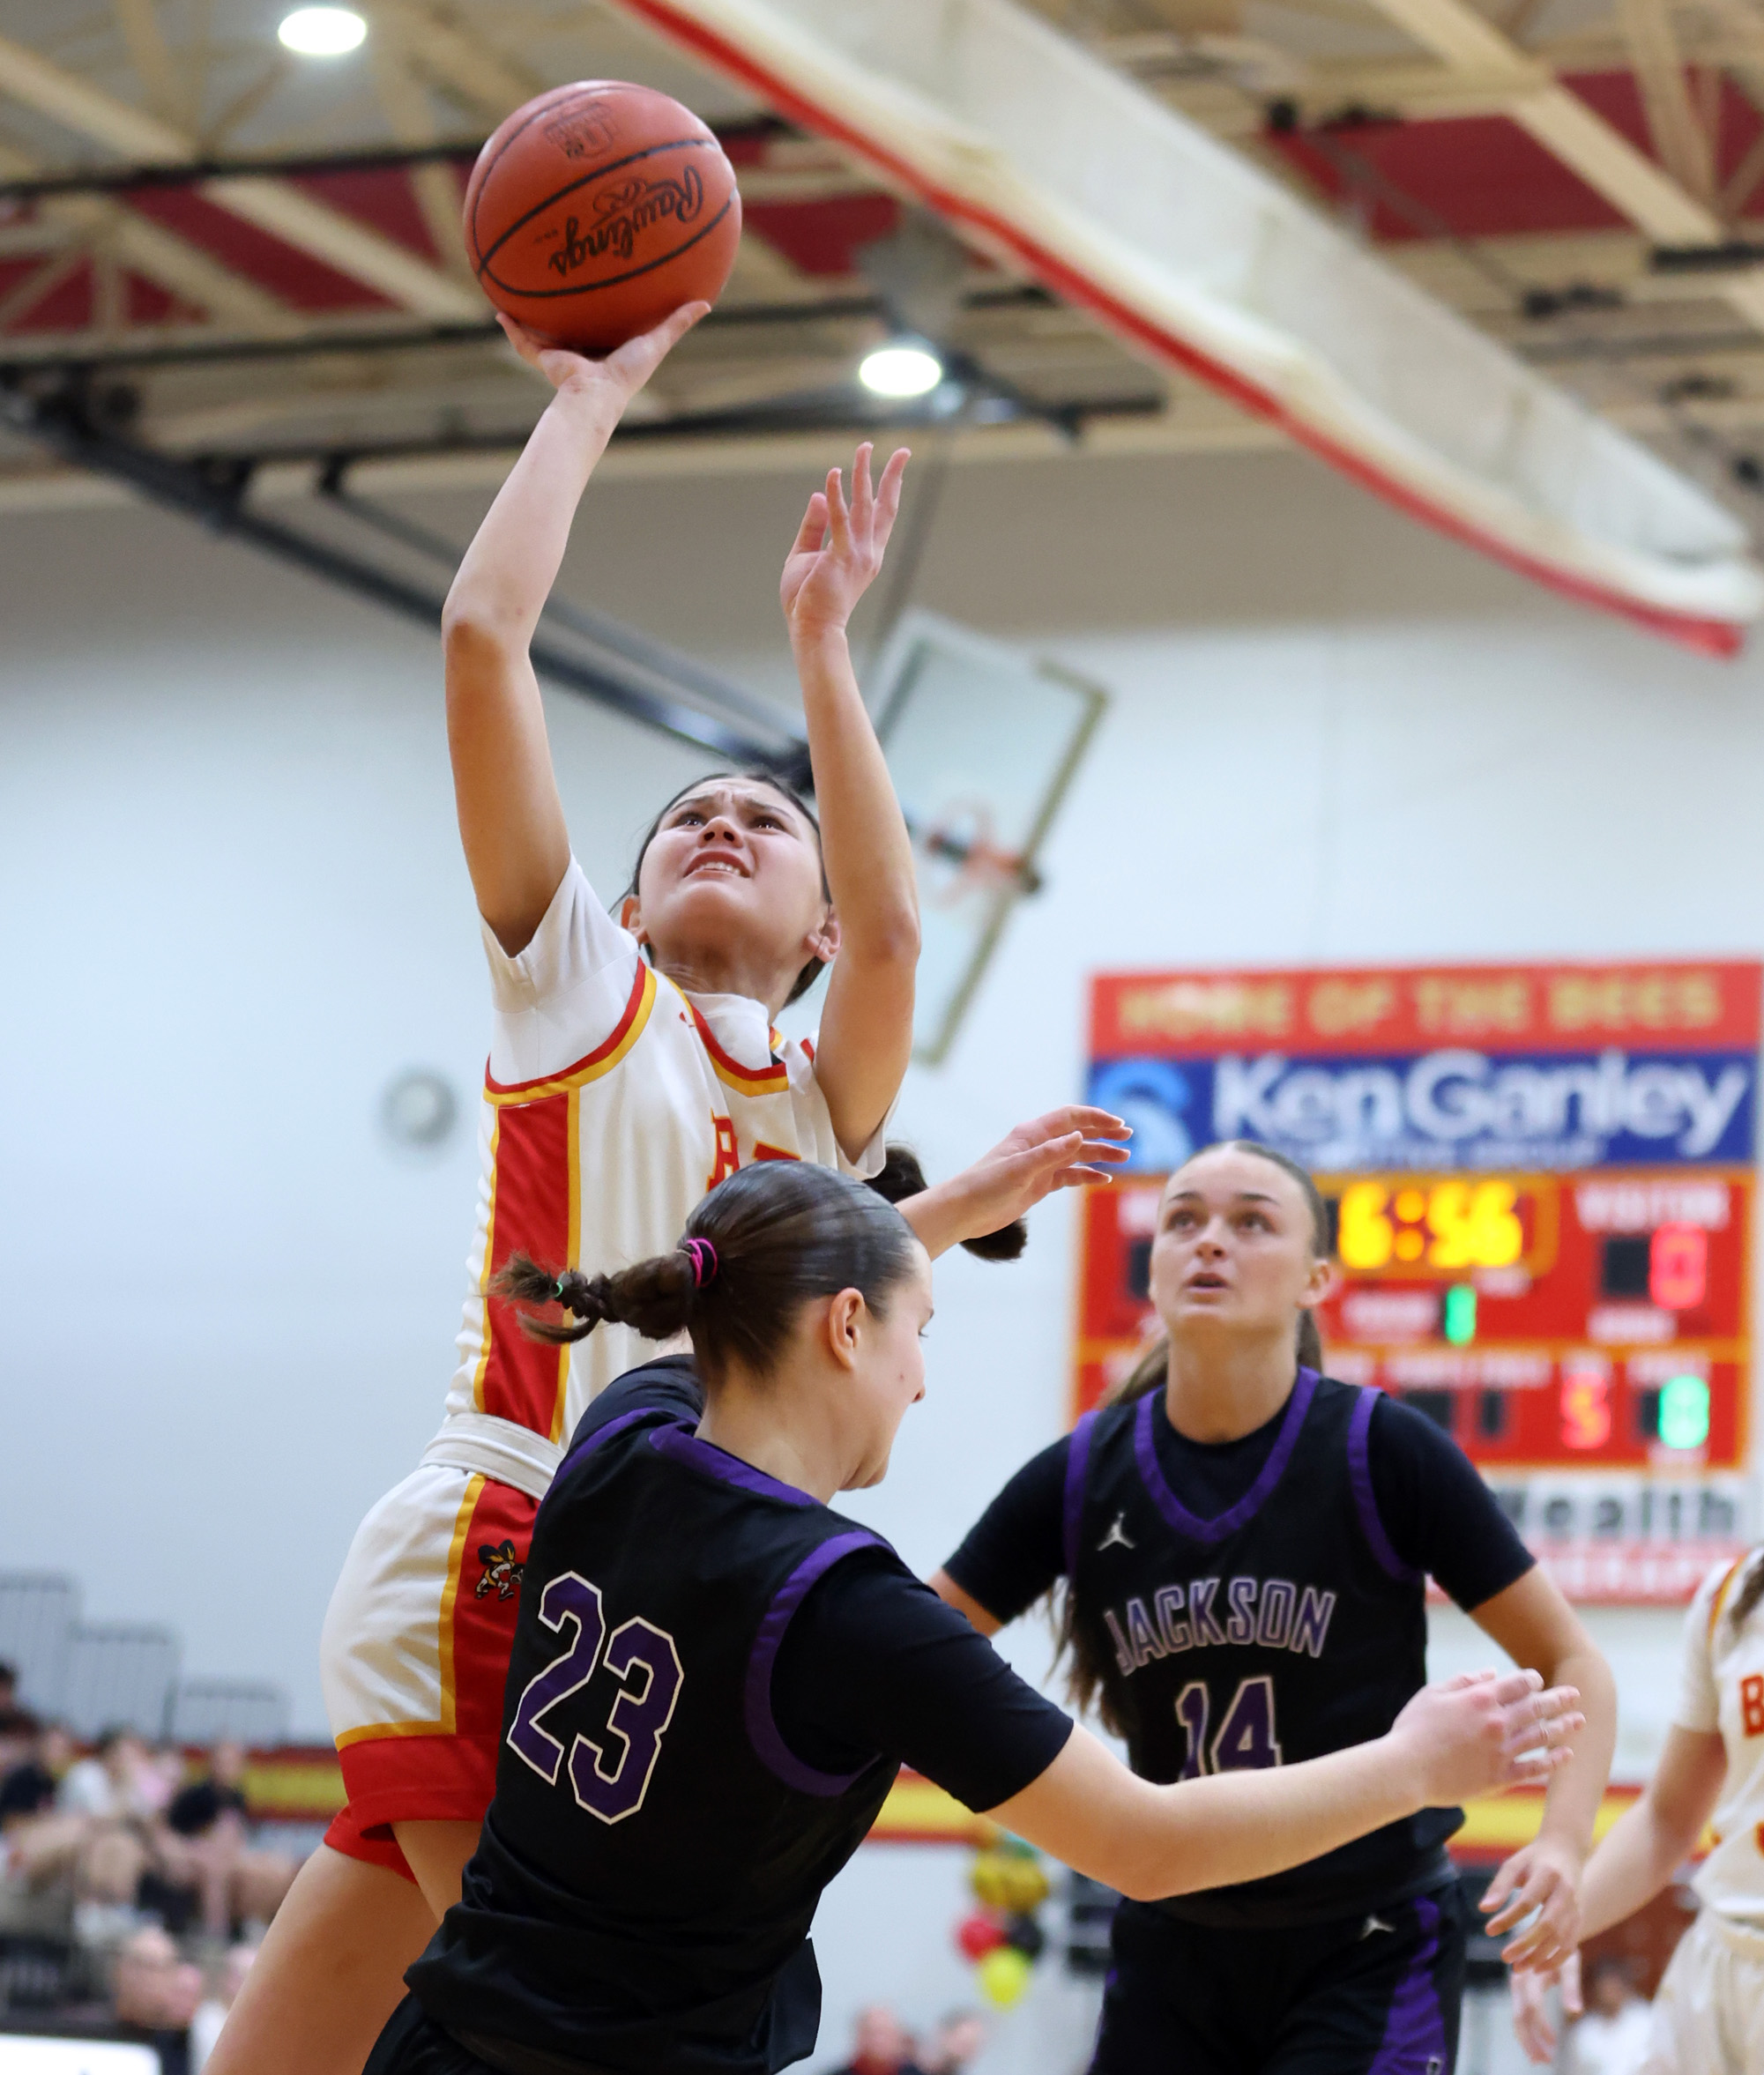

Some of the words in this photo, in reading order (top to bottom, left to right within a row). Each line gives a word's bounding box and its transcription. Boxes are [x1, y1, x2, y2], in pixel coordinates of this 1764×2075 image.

[547, 165, 703, 276] Rawlings
[1118, 982, 1290, 1037] HOME
[1308, 978, 1393, 1035] OF
[1418, 978, 1530, 1032] THE
[1547, 974, 1720, 1030] BEES
[1339, 1180, 1523, 1269] 6:56
[1445, 1283, 1477, 1346] 1
[1104, 1576, 1337, 1677] JACKSON
[506, 1570, 685, 1826] 23
[1174, 1675, 1283, 1782] 14
